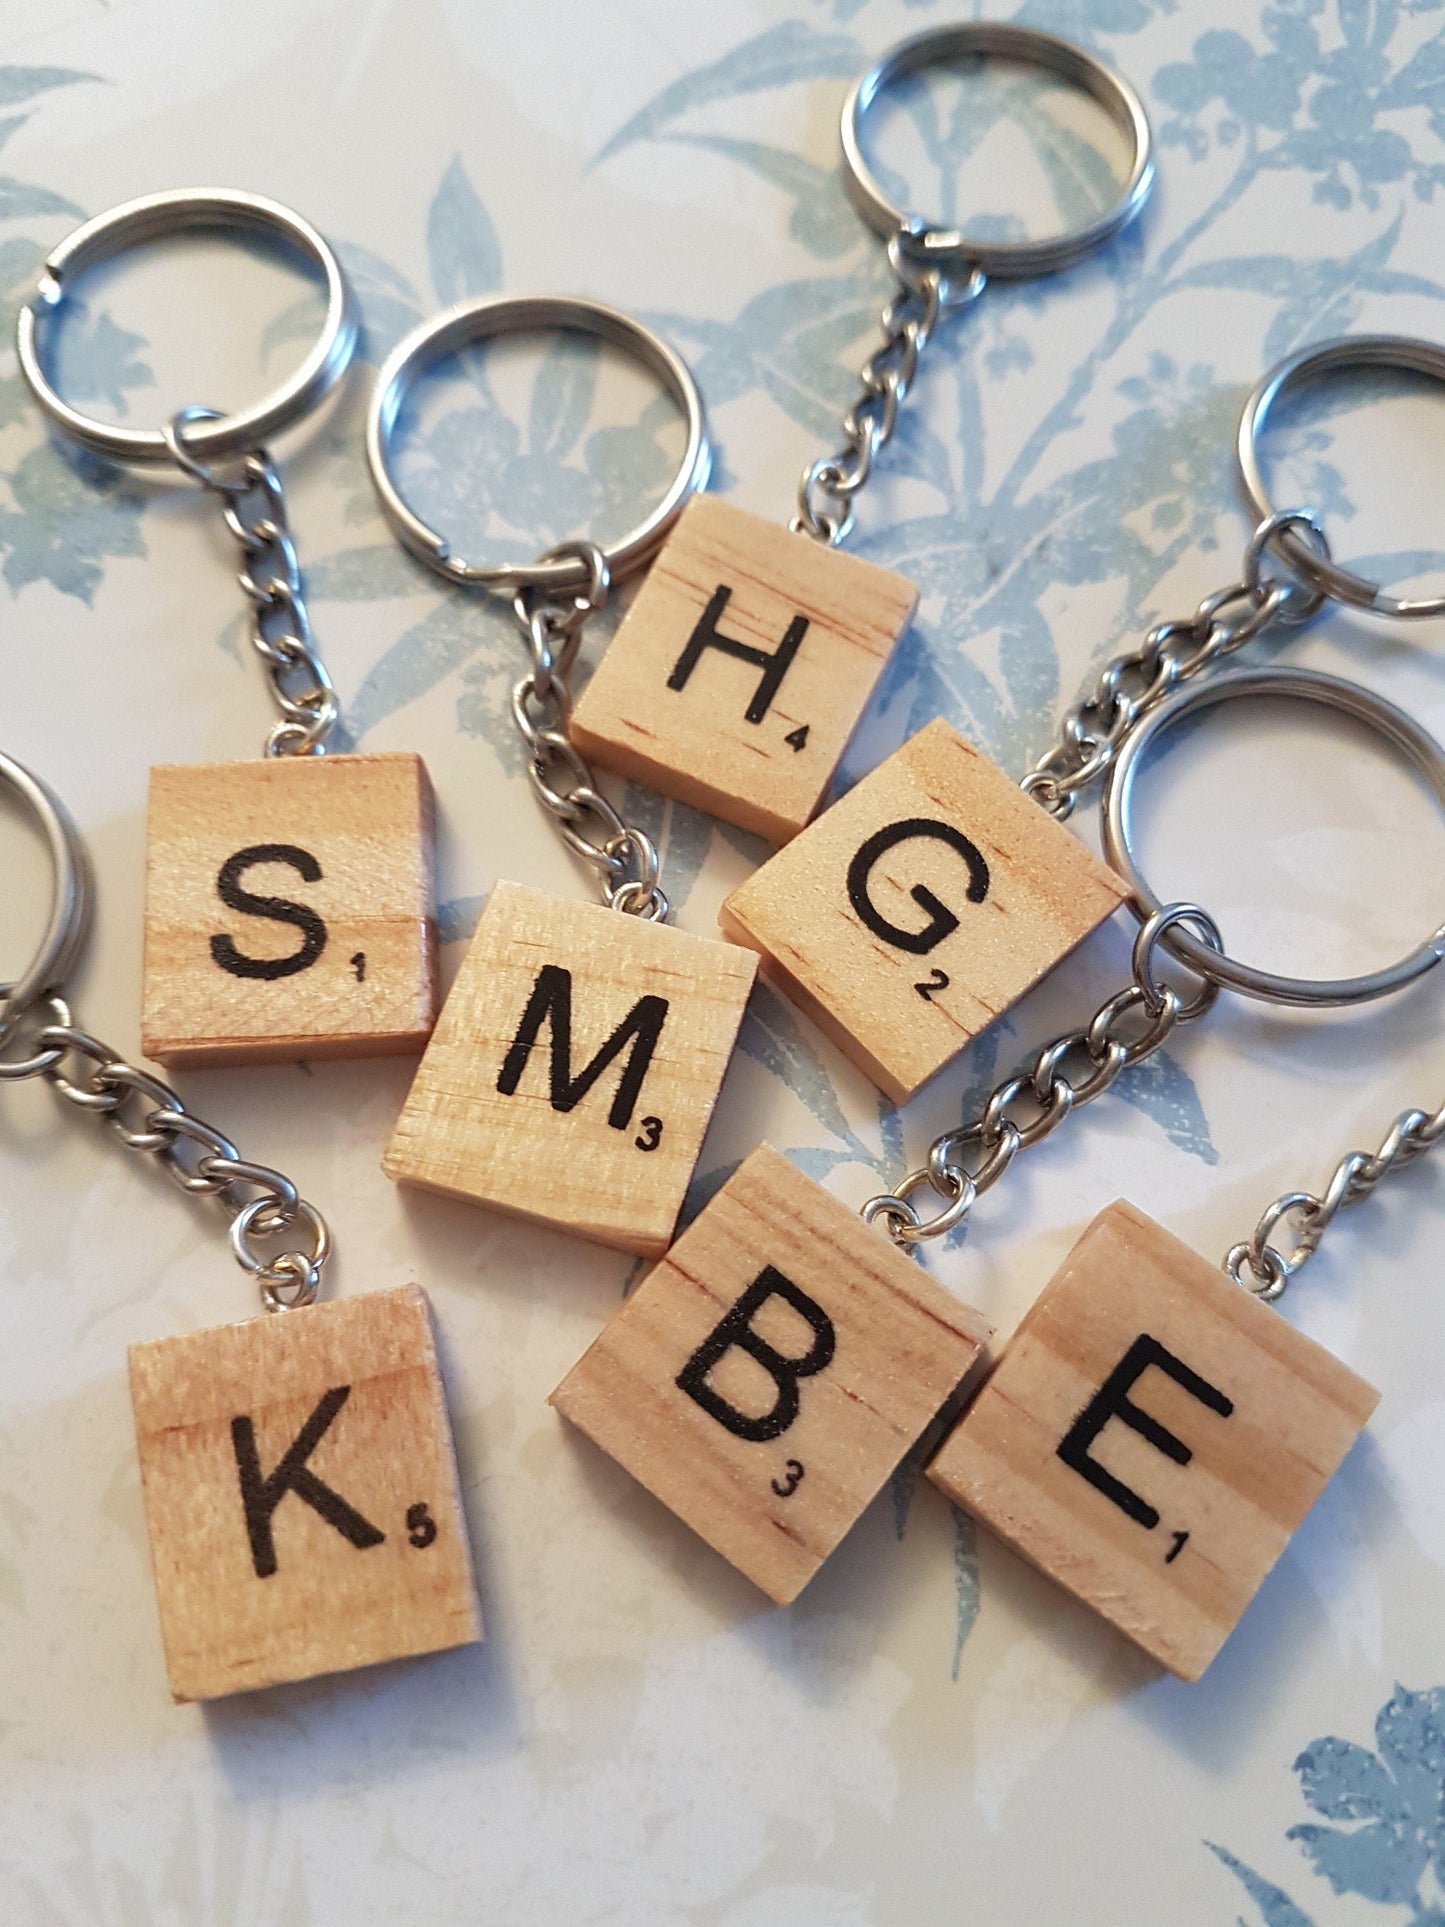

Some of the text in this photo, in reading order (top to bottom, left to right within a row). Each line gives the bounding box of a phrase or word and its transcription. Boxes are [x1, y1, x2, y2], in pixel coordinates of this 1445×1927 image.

[666, 584, 811, 753] H 4
[209, 843, 367, 984] S 1
[846, 817, 990, 1002] G 2
[495, 964, 670, 1152] M 3
[674, 1263, 837, 1499] B 3
[1054, 1332, 1235, 1565] E 1
[230, 1384, 438, 1579] K 5
